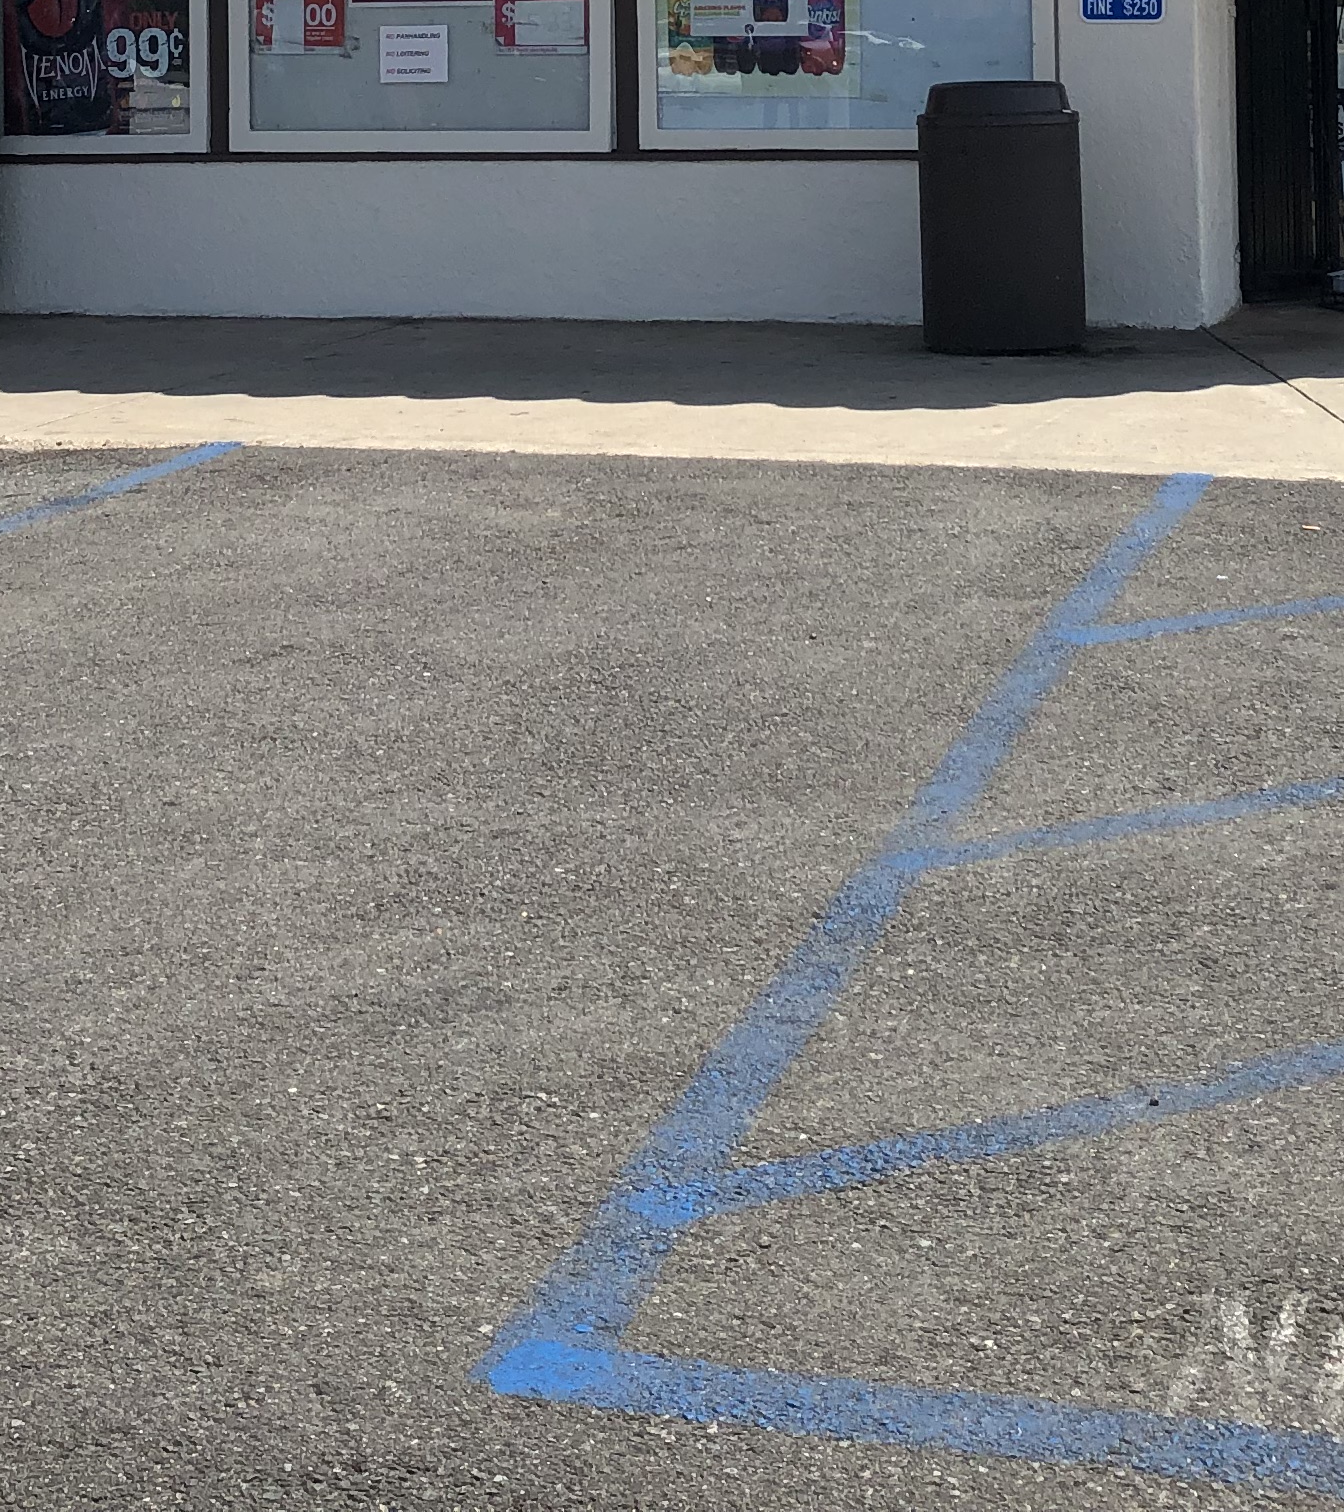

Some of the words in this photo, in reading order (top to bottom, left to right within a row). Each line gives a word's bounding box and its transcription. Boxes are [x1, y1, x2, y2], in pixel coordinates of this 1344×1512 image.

[1087, 0, 1113, 16] FINE
[1123, 0, 1158, 17] $250
[106, 27, 183, 78] 99¢
[20, 35, 107, 110] VENOM
[43, 86, 89, 100] ENERGY
